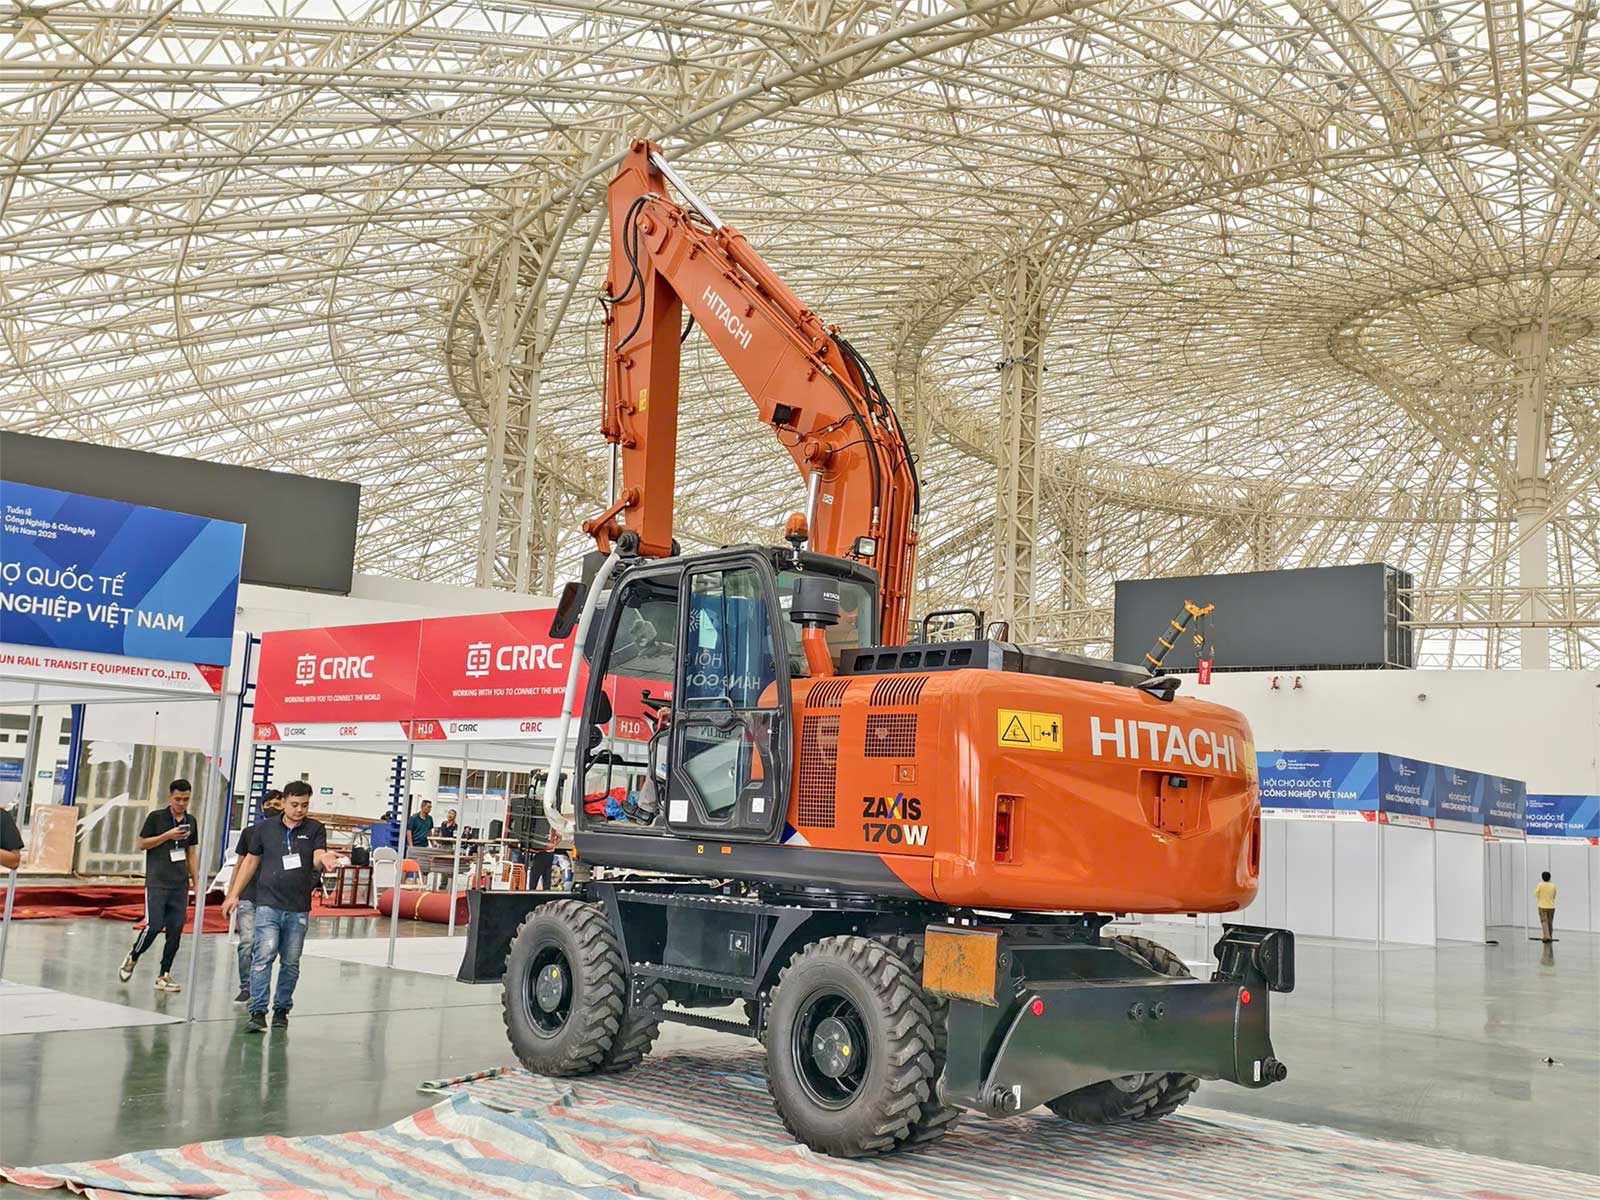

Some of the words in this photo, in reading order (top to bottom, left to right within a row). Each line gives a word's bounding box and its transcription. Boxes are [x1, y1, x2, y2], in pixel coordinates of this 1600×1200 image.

[702, 284, 753, 350] HITACHI
[4, 524, 20, 534] Việt
[20, 527, 37, 536] Nam
[37, 530, 57, 539] 2025
[5, 514, 25, 525] Công
[25, 518, 51, 529] Nghiệp
[51, 522, 57, 530] &
[58, 524, 77, 534] Công
[77, 526, 96, 537] Nghệ
[0, 561, 21, 586] Ợ
[26, 564, 94, 592] QUỐC
[99, 572, 127, 597] TẾ
[86, 602, 134, 629] VIỆT
[137, 609, 184, 632] NAM
[17, 656, 41, 667] RAIL
[43, 658, 88, 671] TRANSIT
[90, 663, 149, 676] EQUIPMENT
[320, 655, 375, 680] CRRC
[496, 643, 565, 671] CRRC
[513, 687, 540, 695] CONNECT
[258, 727, 271, 737] H09
[339, 726, 358, 736] CRRC
[417, 723, 434, 734] H10
[458, 723, 478, 732] CRRC
[519, 721, 543, 733] CRRC
[620, 721, 640, 734] H10
[1090, 716, 1237, 772] HITACHI
[1263, 777, 1277, 789] HỘI
[1277, 778, 1296, 789] CHỢ
[1296, 777, 1321, 788] QUỐC
[1321, 777, 1333, 788] TẾ
[1263, 788, 1287, 798] CÔNG
[1288, 789, 1318, 800] NGHIỆP
[1318, 789, 1336, 800] VIỆT
[1337, 791, 1357, 800] NAM
[862, 792, 922, 821] ZAXIS
[1536, 812, 1556, 821] QUỐC
[1556, 813, 1565, 821] TẾ
[862, 822, 929, 846] 170W
